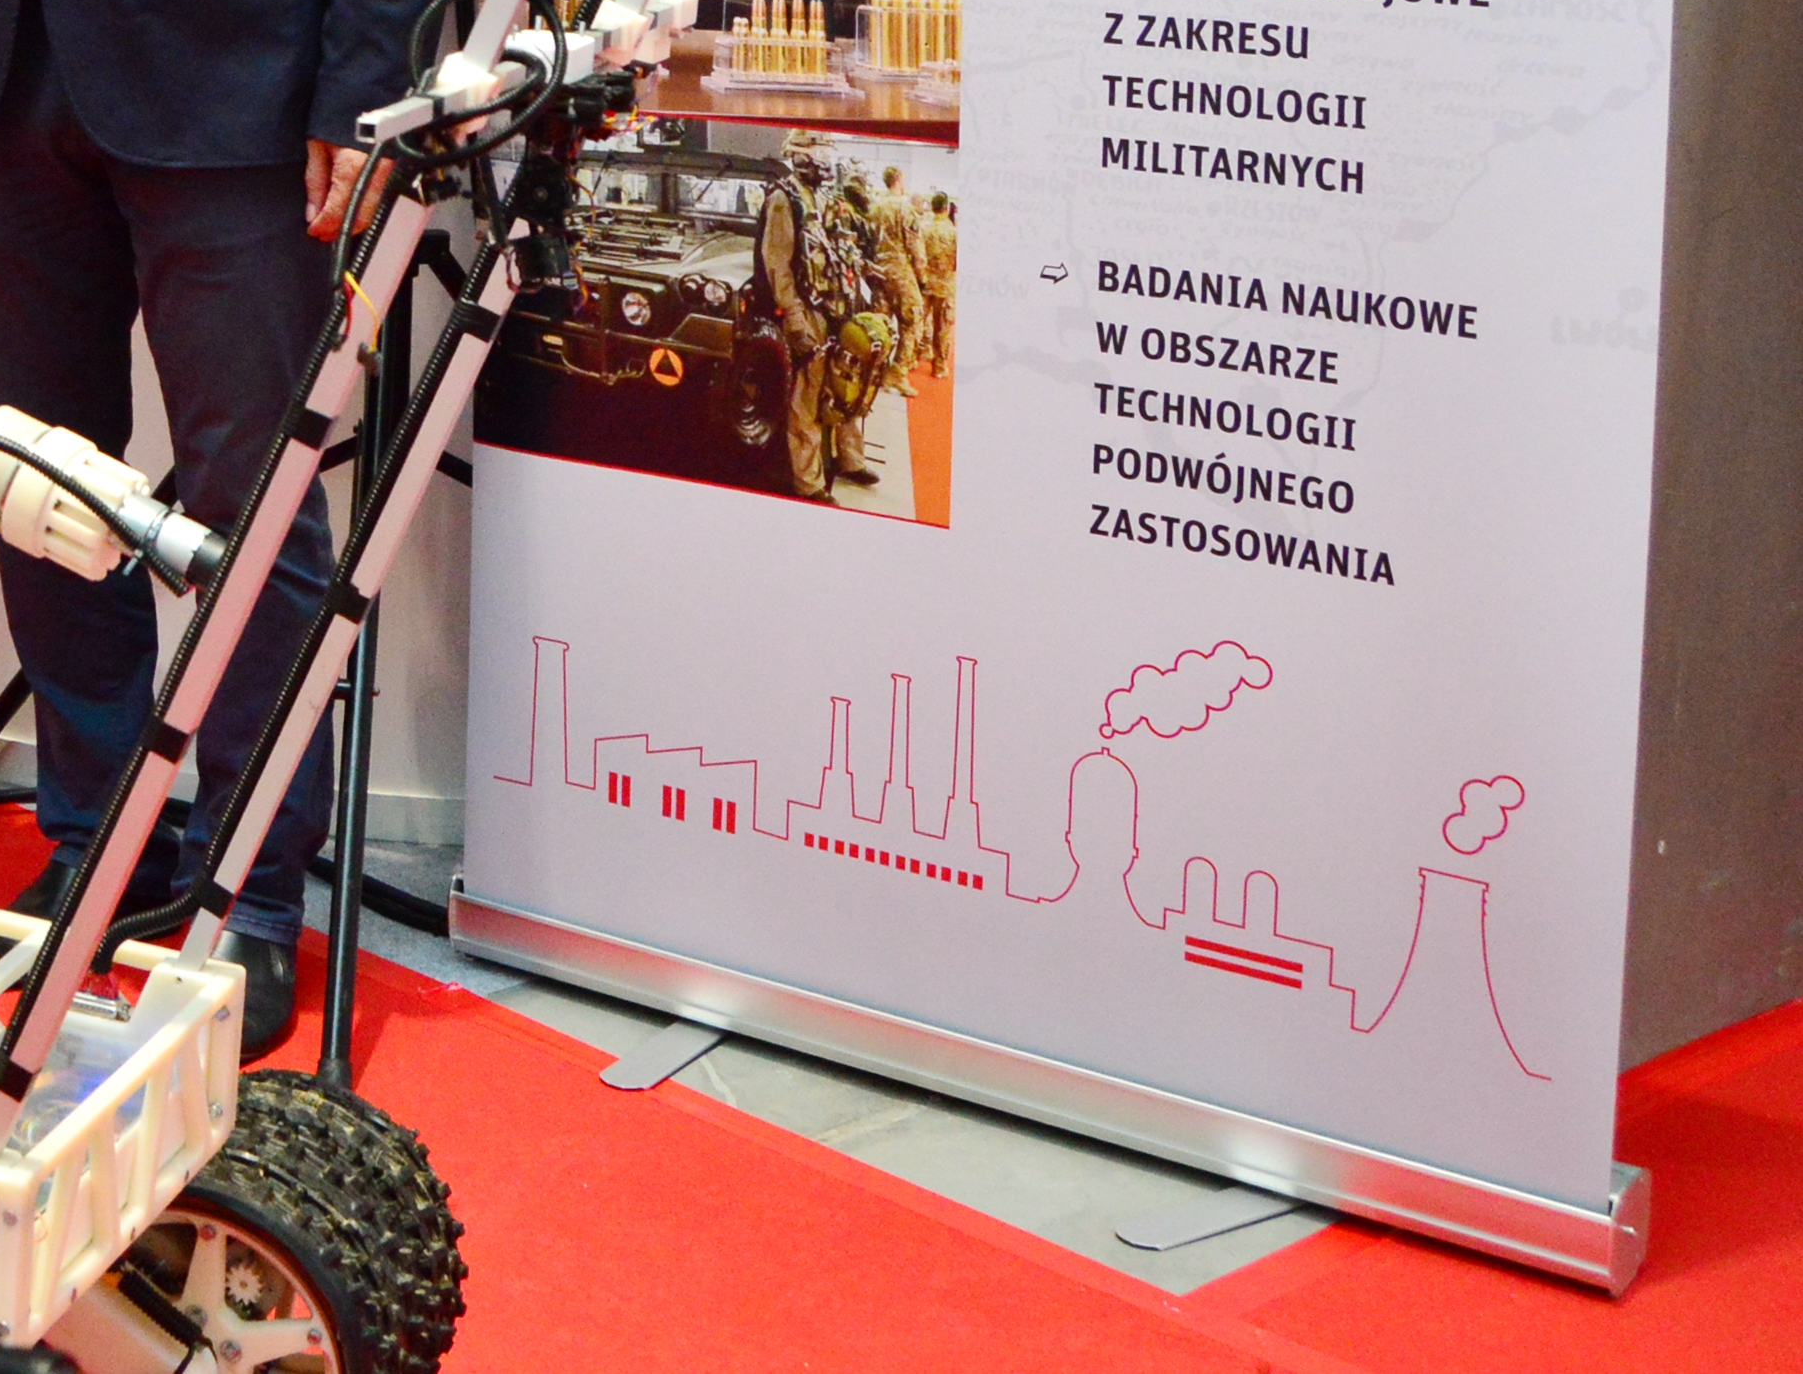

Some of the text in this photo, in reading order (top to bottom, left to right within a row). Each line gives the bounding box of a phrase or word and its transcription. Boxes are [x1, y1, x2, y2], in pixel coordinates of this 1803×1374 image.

[1104, 13, 1124, 44] Z
[1136, 15, 1310, 59] ZAKRESU
[1103, 75, 1367, 129] TECHNOLOGII
[1101, 137, 1364, 194] MILITARNYCH
[1098, 260, 1478, 340] BADANIA NAUKOWE
[1096, 321, 1338, 384] W OBSZARZE
[1095, 382, 1356, 451] TECHNOLOGII
[1092, 443, 1354, 513] PODWÓJNEGO
[1090, 504, 1395, 586] ZASTOSOWANIA
